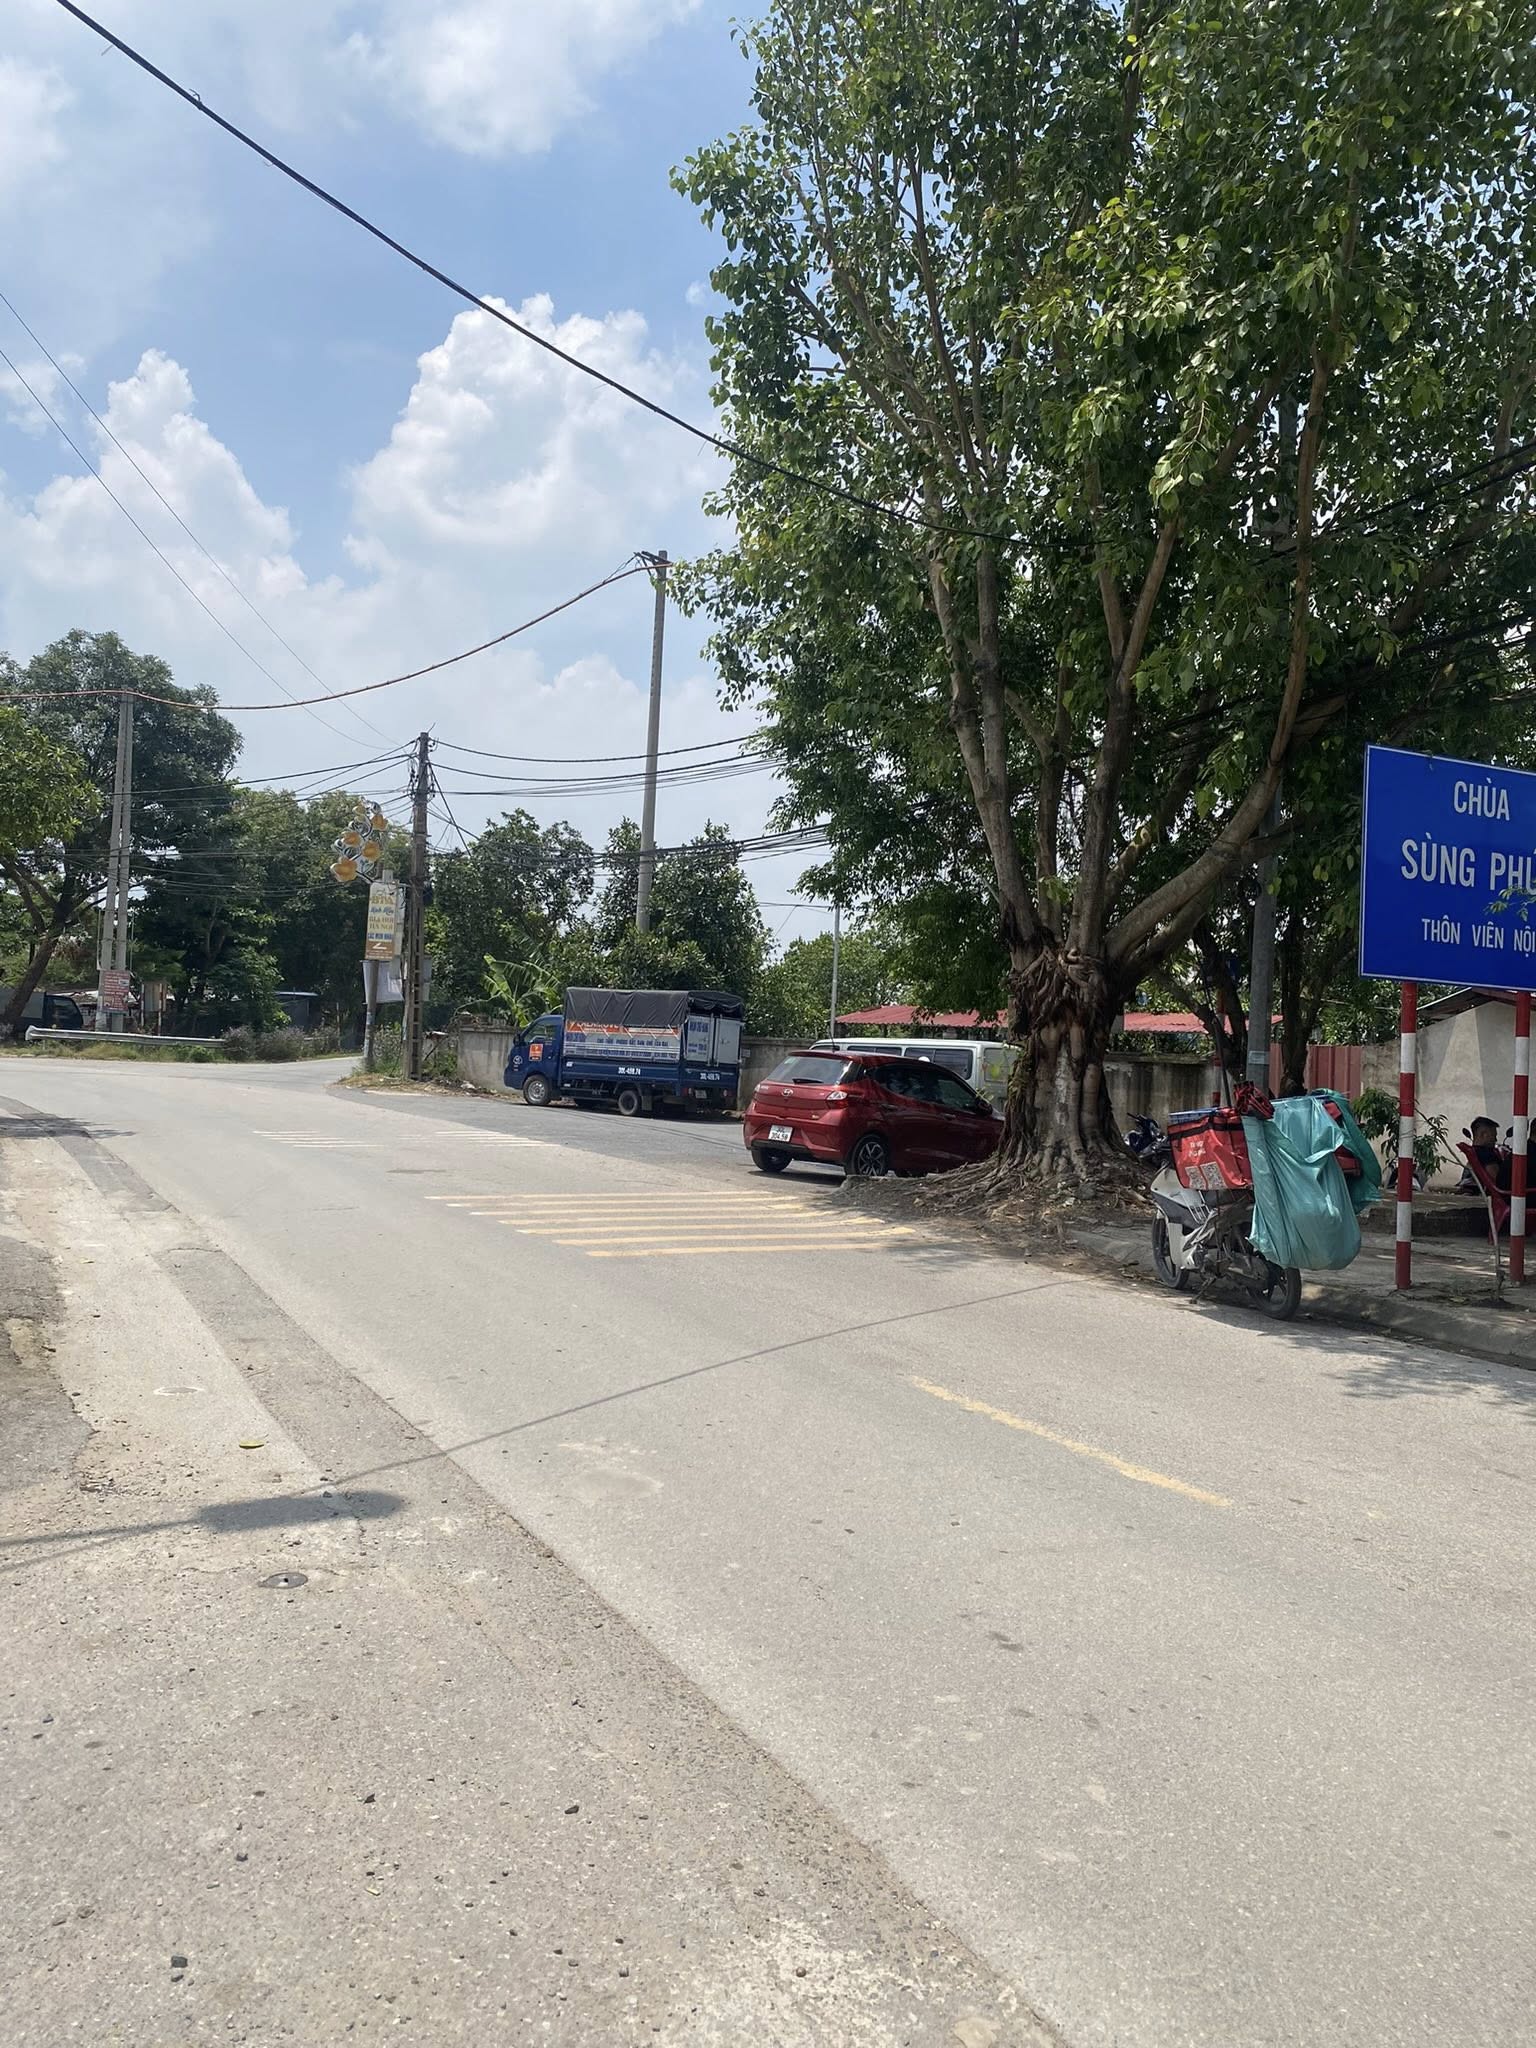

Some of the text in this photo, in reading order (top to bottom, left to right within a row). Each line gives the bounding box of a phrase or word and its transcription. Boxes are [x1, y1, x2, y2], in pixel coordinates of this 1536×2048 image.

[1453, 777, 1510, 821] CHÙA
[1400, 831, 1476, 888] SÙNG
[1421, 914, 1536, 958] THÔN VIÊN NỘI
